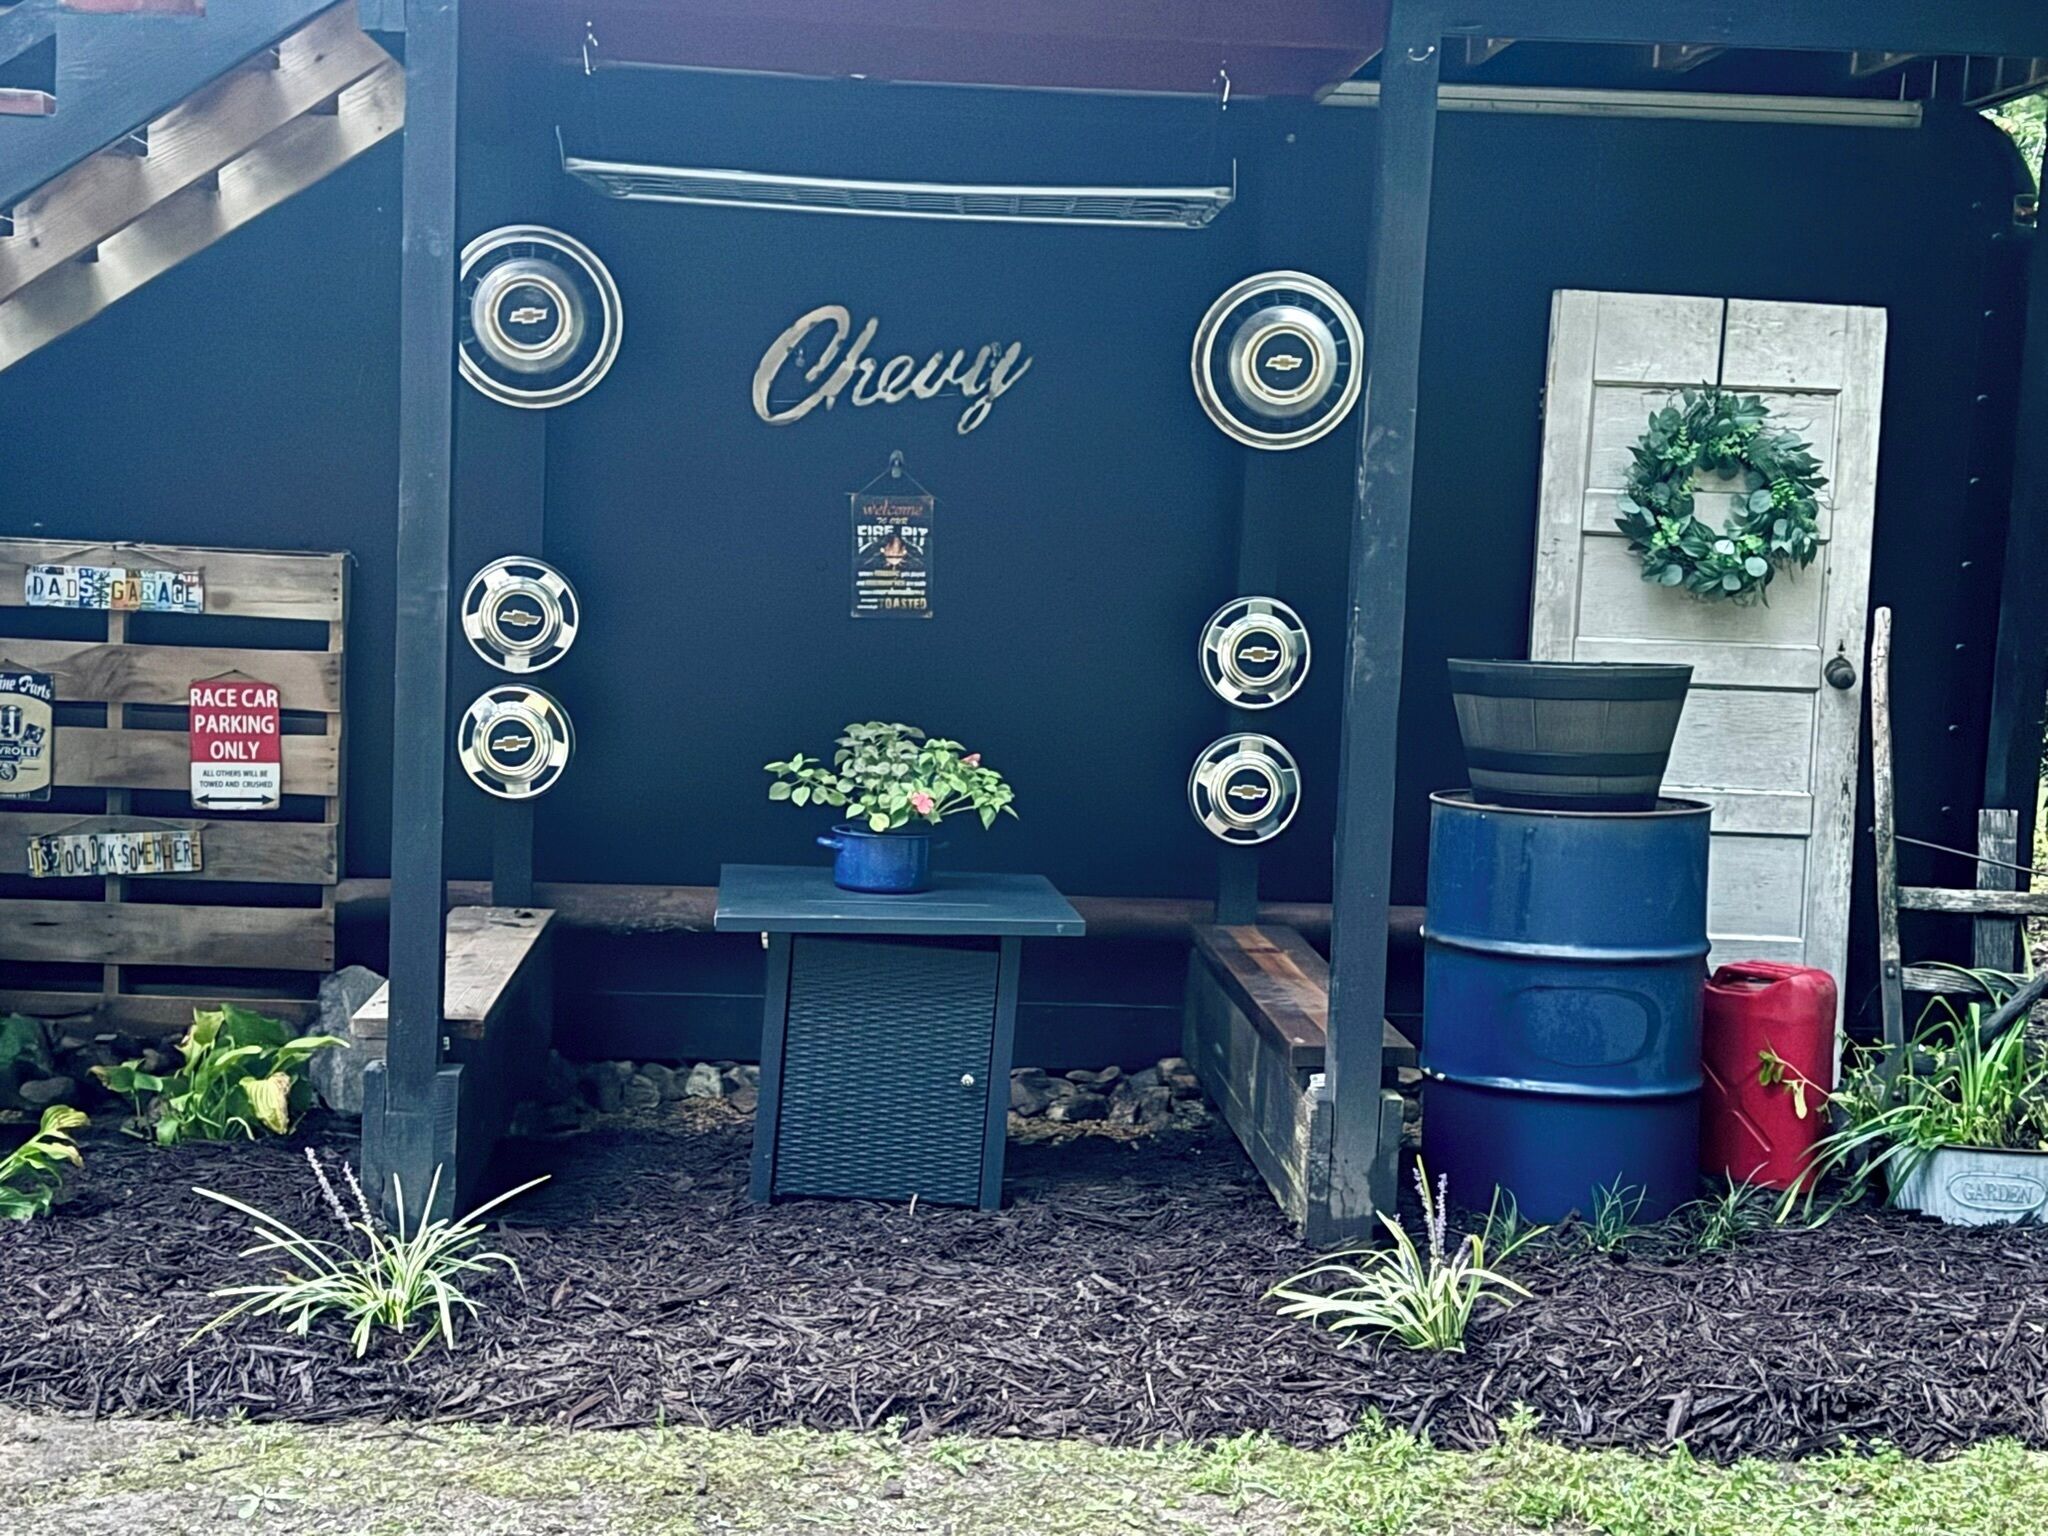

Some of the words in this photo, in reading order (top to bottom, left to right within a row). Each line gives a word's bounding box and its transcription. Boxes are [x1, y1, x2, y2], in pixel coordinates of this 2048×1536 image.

[752, 304, 1033, 435] Chevy
[857, 525, 894, 547] FIRE
[901, 526, 928, 547] PIT
[112, 580, 196, 604] GARAGE
[18, 674, 51, 700] Parts
[190, 688, 237, 707] RACE
[241, 689, 278, 708] CAR
[194, 714, 275, 734] PARKING
[209, 740, 260, 760] ONLY
[1962, 1183, 2033, 1204] GARDEN
